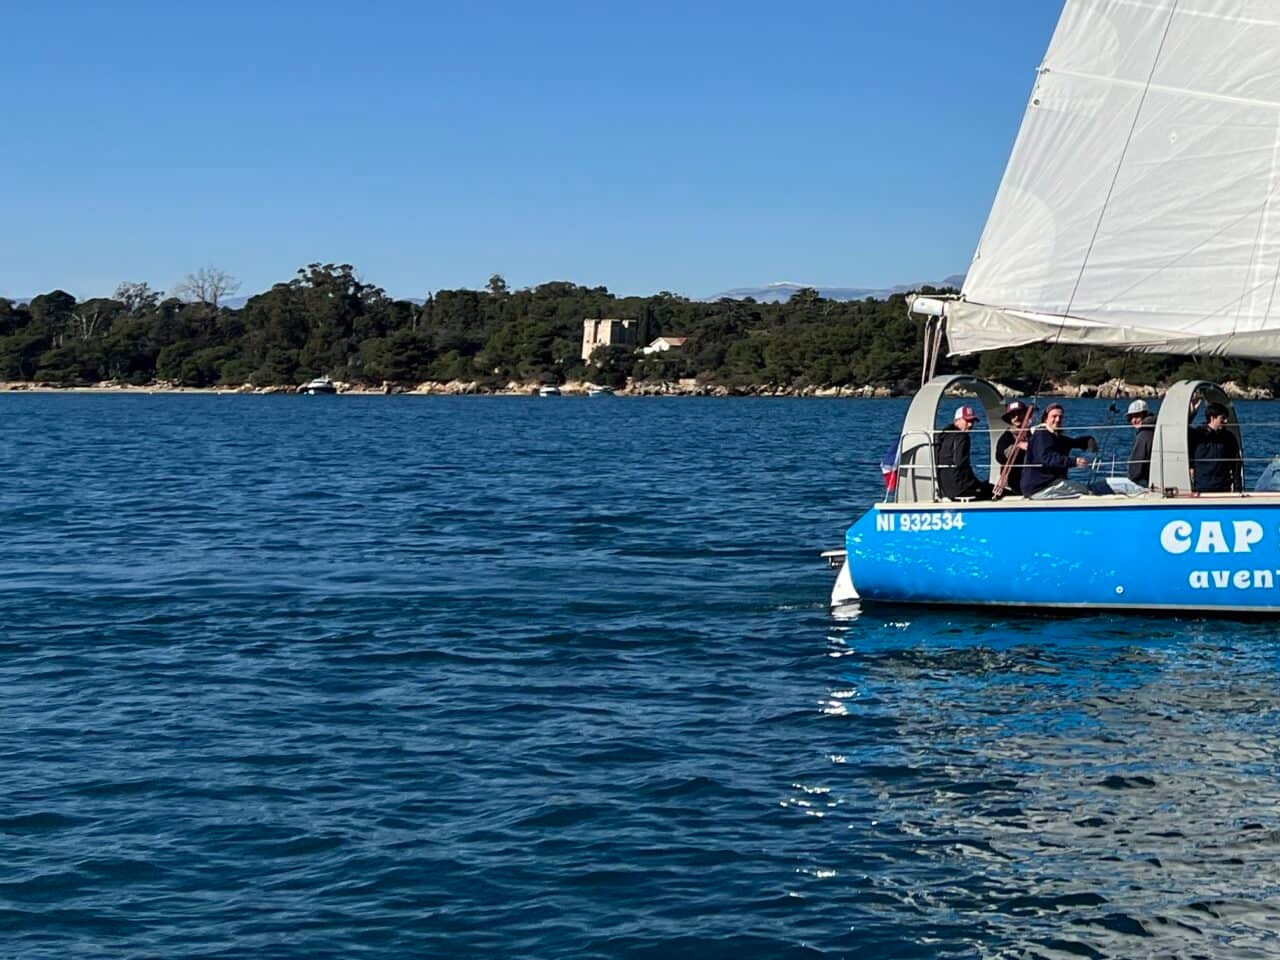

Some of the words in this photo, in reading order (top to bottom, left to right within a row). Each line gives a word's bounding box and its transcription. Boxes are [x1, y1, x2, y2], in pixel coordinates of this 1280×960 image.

[876, 513, 895, 531] NI
[900, 512, 964, 531] 932534
[1160, 520, 1264, 554] CAP
